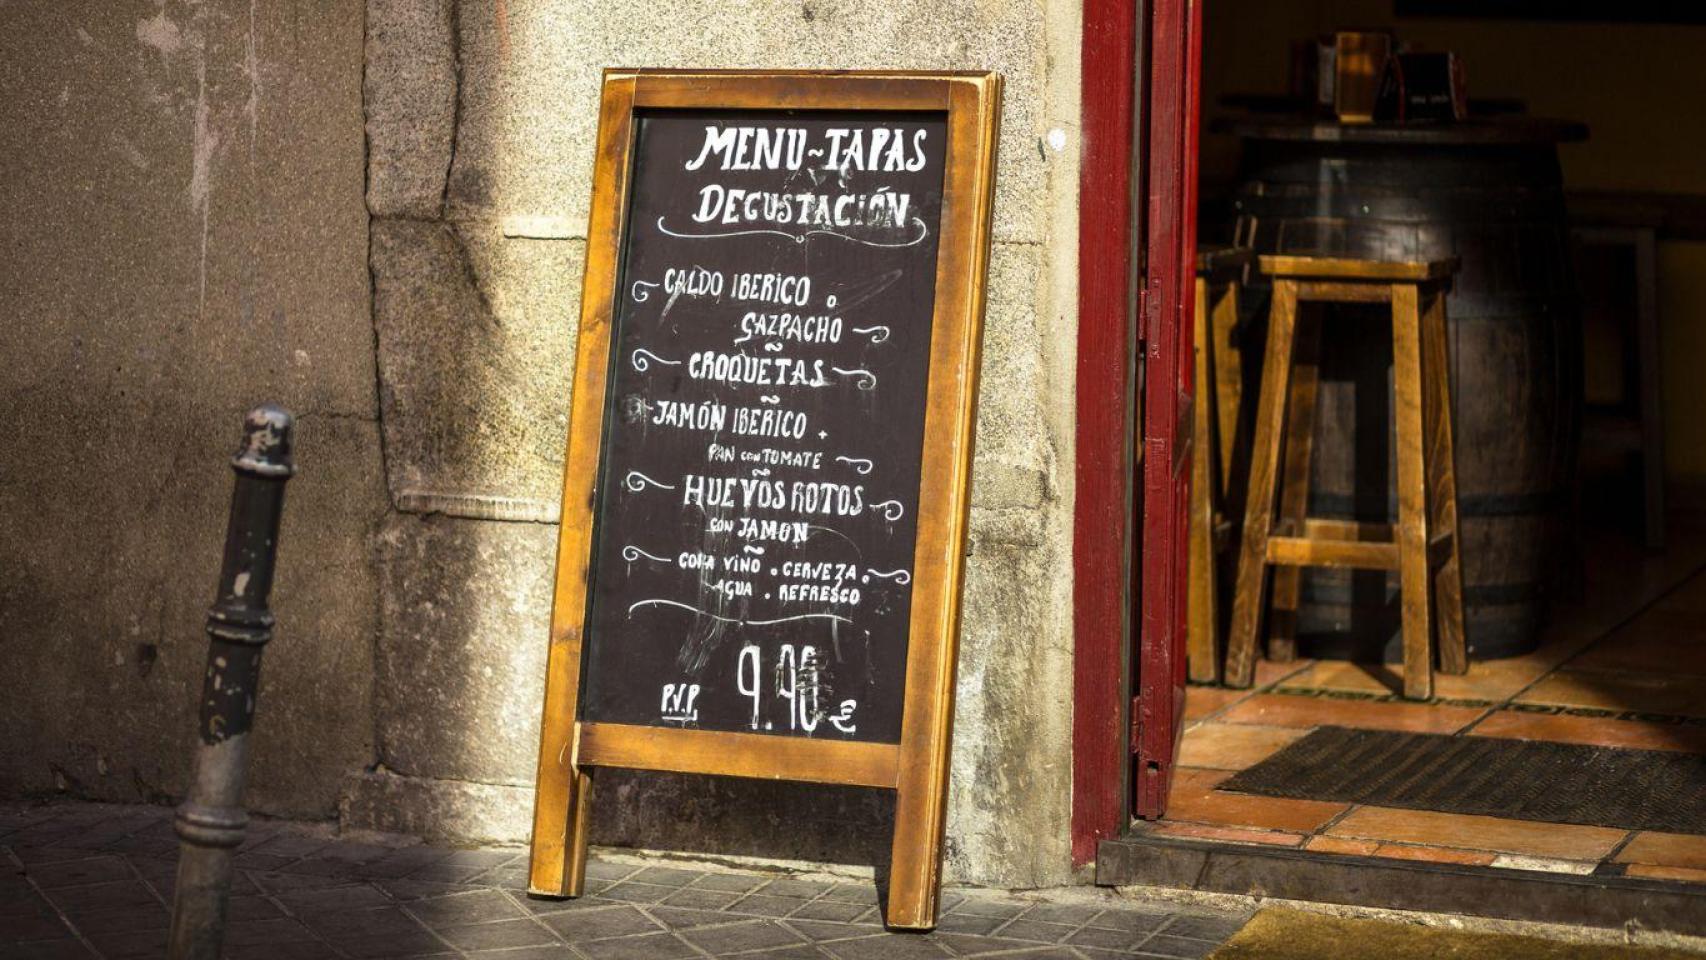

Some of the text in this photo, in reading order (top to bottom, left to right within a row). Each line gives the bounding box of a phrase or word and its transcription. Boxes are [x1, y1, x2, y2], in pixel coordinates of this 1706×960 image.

[665, 268, 723, 297] CALDO
[734, 312, 842, 344] GAZPACHO
[688, 351, 825, 387] CROQUETAS
[653, 400, 726, 431] JAMÓN
[732, 407, 807, 439] IBERICO
[708, 444, 735, 463] PAN
[761, 448, 822, 469] TOMATE
[684, 475, 864, 516] HUEVOS ROTOS
[709, 517, 735, 532] CON
[779, 584, 860, 605] REFRESCO
